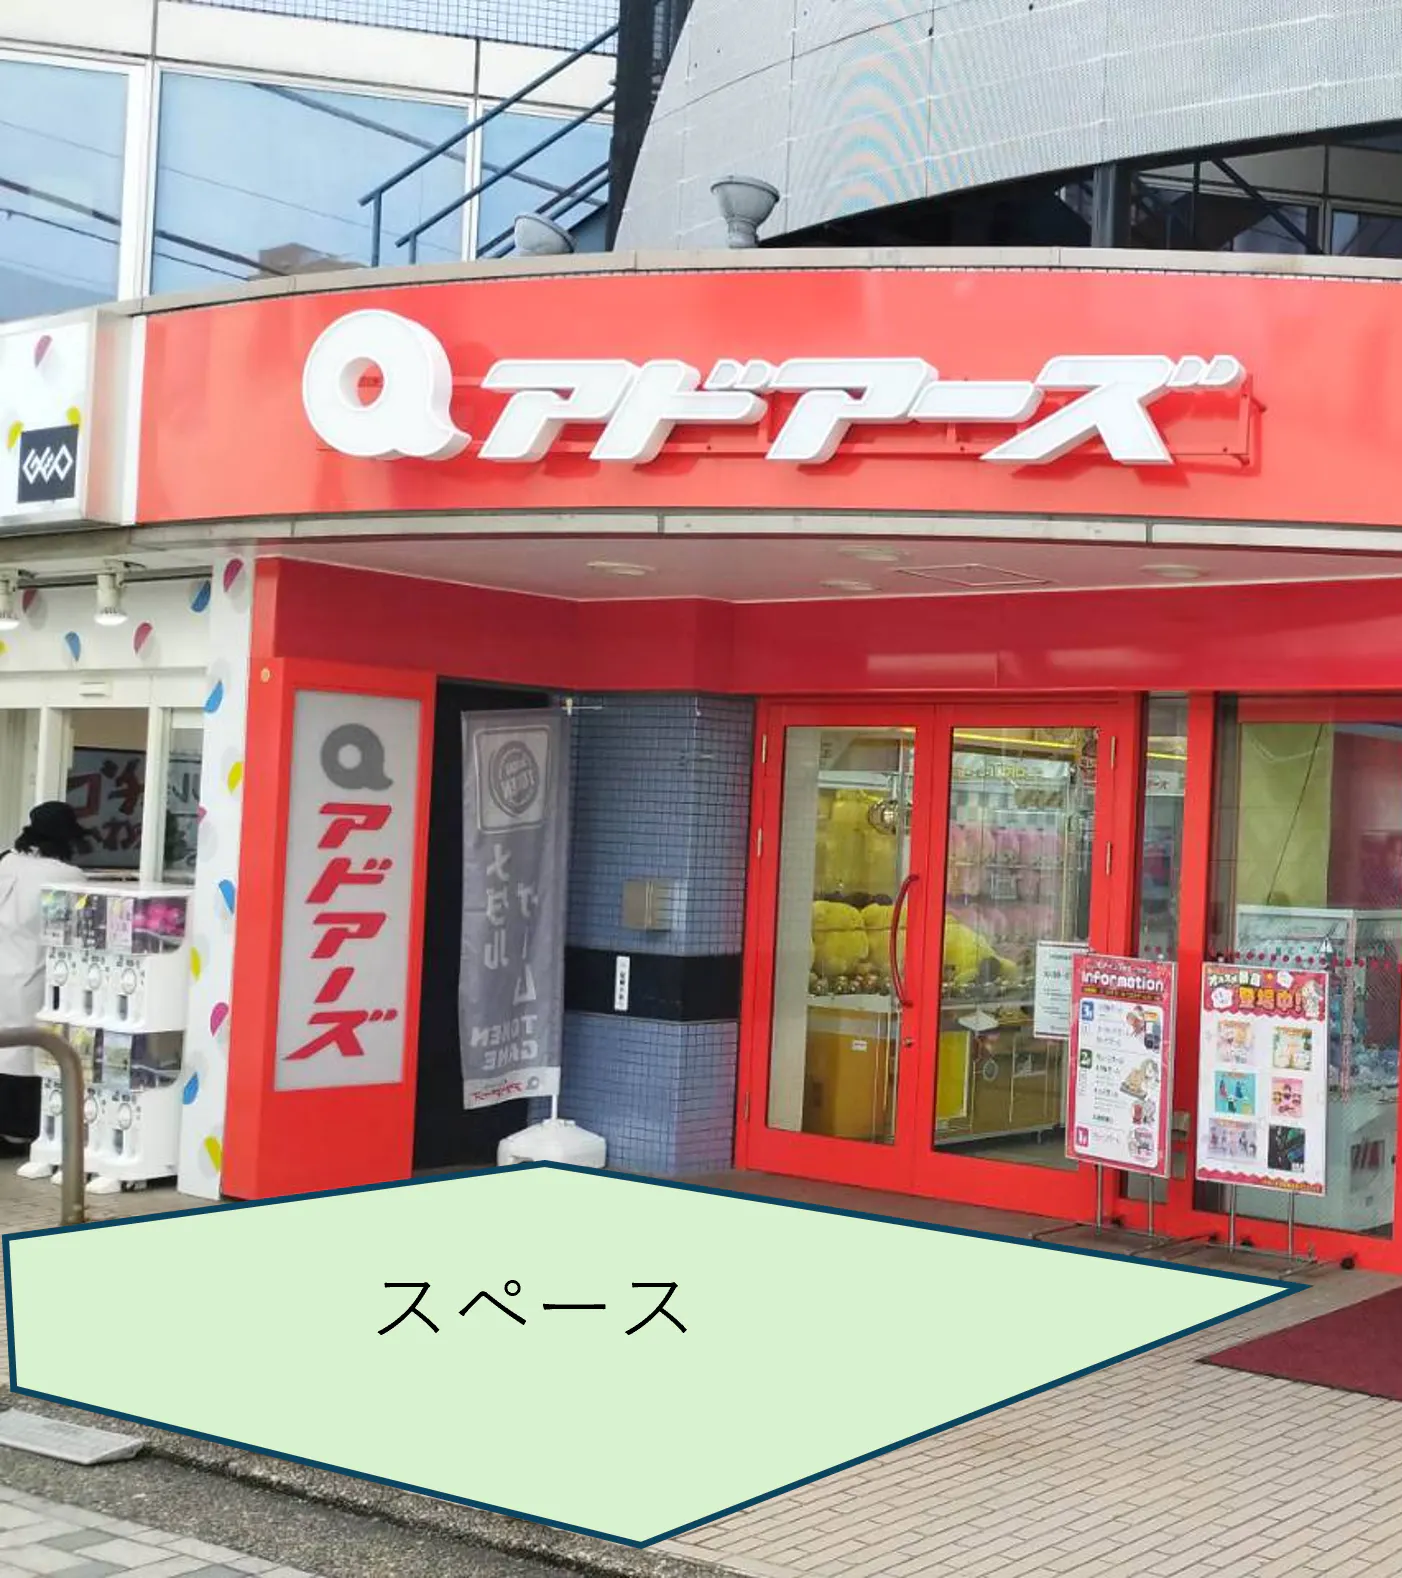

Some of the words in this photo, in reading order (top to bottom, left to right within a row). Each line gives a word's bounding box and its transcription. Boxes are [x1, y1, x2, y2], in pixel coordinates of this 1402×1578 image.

[478, 353, 1243, 467] アドアーズ
[282, 802, 398, 1061] アドアーズ
[1081, 969, 1164, 992] Information
